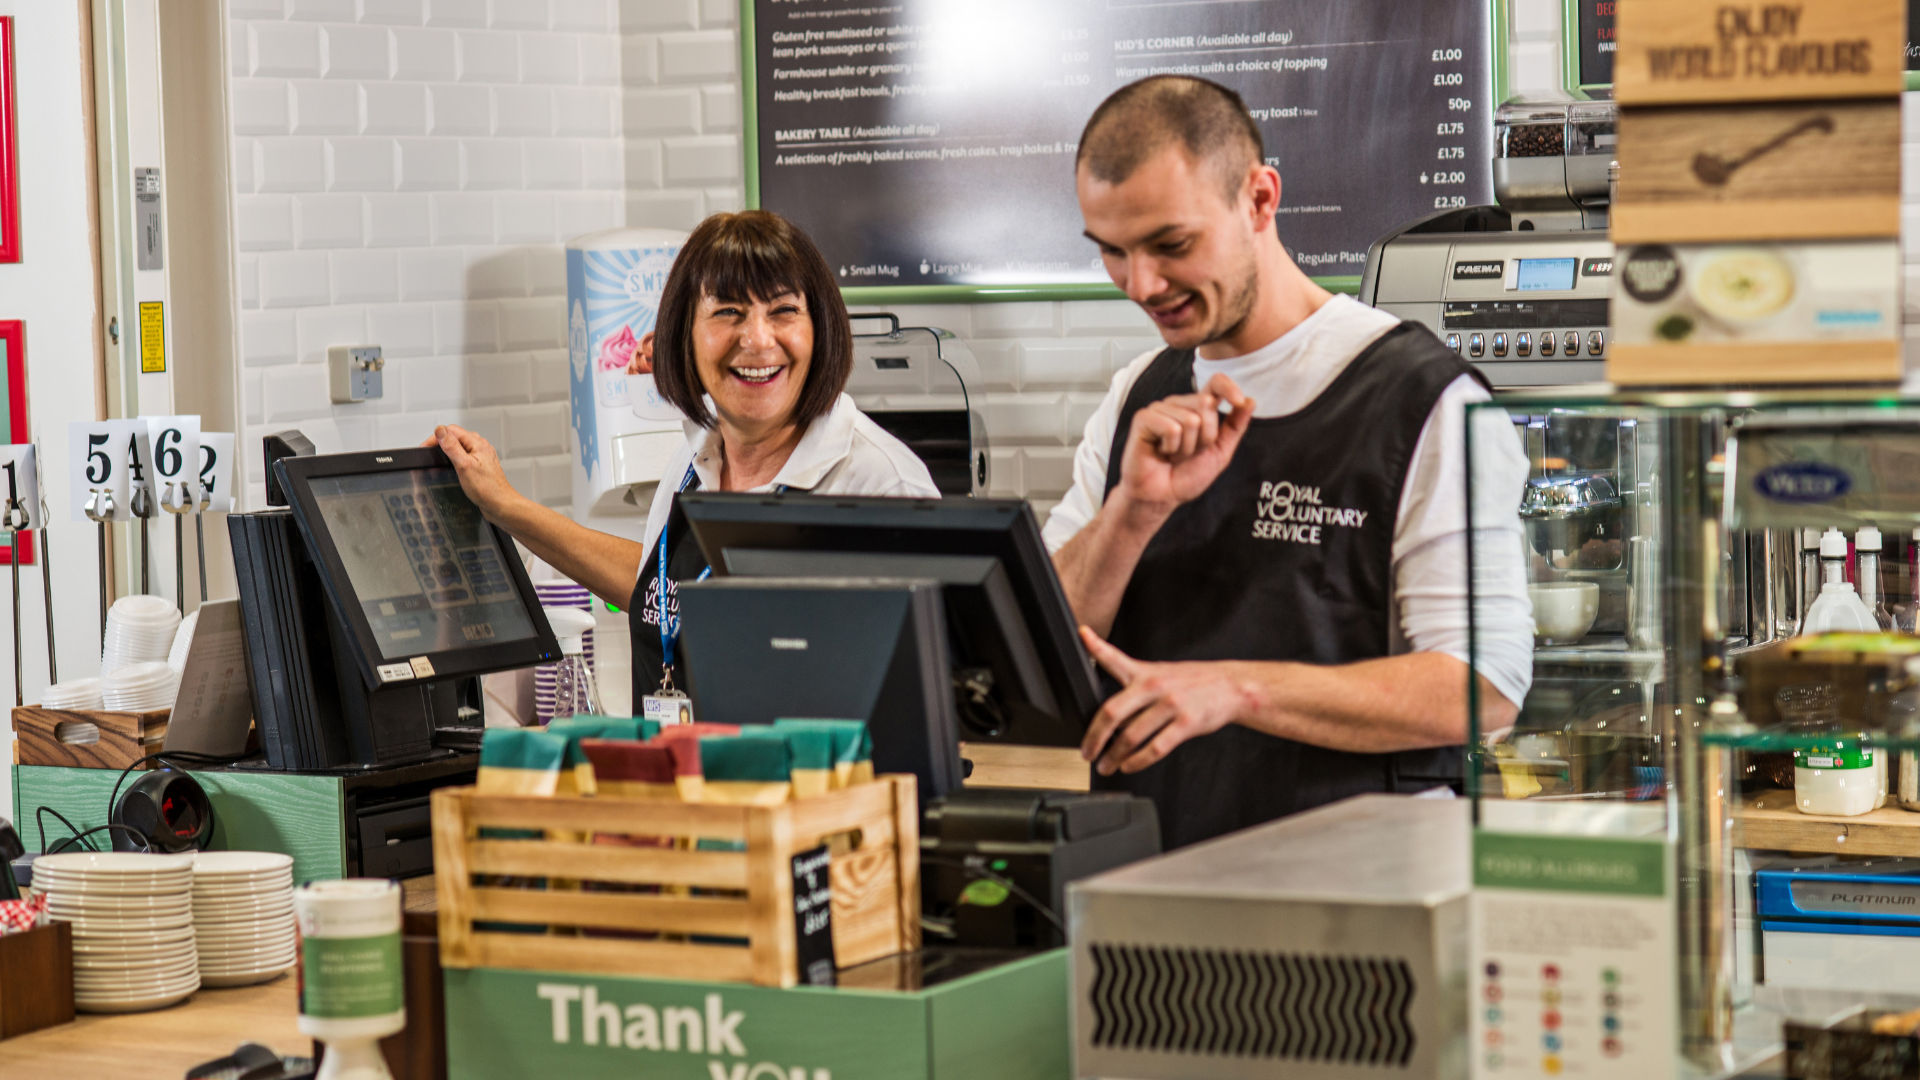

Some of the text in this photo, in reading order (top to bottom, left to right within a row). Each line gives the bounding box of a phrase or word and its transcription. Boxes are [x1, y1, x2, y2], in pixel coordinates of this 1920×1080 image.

[772, 32, 804, 43] Gluten
[804, 30, 825, 43] free
[826, 26, 872, 40] multiseed
[874, 27, 886, 36] or
[886, 24, 913, 35] white
[1114, 30, 1294, 51] KID'S CORNER (Available all day)
[772, 47, 794, 58] lean
[795, 46, 818, 58] pork
[820, 44, 863, 56] sausages
[864, 42, 876, 52] or
[877, 43, 884, 52] a
[1432, 49, 1462, 62] £1.00
[773, 68, 827, 80] Farmhouse
[828, 66, 856, 78] white
[856, 66, 868, 76] or
[870, 63, 912, 78] granary
[1114, 56, 1328, 78] Warm pancakes with a choice of topping
[1433, 74, 1463, 86] £1.00
[774, 88, 812, 102] Healthy
[812, 86, 858, 101] breakfast
[860, 86, 890, 98] bowls,
[1448, 98, 1472, 112] 50p
[1250, 110, 1268, 122] ary
[1270, 106, 1298, 118] toast
[775, 122, 940, 142] BAKERY TABLE (Available all day)
[1436, 122, 1464, 136] £1.75
[776, 154, 784, 165] A
[785, 153, 826, 165] selection
[827, 152, 838, 166] of
[838, 150, 872, 166] freshly
[874, 149, 904, 161] baked
[906, 148, 940, 161] scones,
[940, 146, 967, 161] fresh
[968, 148, 1000, 158] cakes,
[1000, 146, 1022, 158] tray
[1024, 143, 1053, 154] bakes
[1054, 142, 1062, 152] &
[1437, 148, 1465, 160] £1.75
[1433, 172, 1466, 184] £2.00
[1300, 204, 1320, 213] baked
[1322, 204, 1342, 212] beans
[1434, 196, 1466, 208] £2.50
[1298, 250, 1366, 266] Regular Plate
[850, 264, 900, 278] Small Mug
[932, 262, 958, 275] Large
[606, 378, 629, 397] SWI
[86, 433, 112, 484] 5
[129, 432, 145, 481] 4
[154, 428, 182, 478] 6
[200, 445, 218, 494] 2
[2, 459, 18, 501] 1
[1259, 480, 1322, 505] ROYAL
[1256, 496, 1369, 529] VOLUNTARY
[1252, 518, 1322, 545] SERVICE
[1831, 893, 1917, 905] PLATINUM
[536, 982, 748, 1057] Thank
